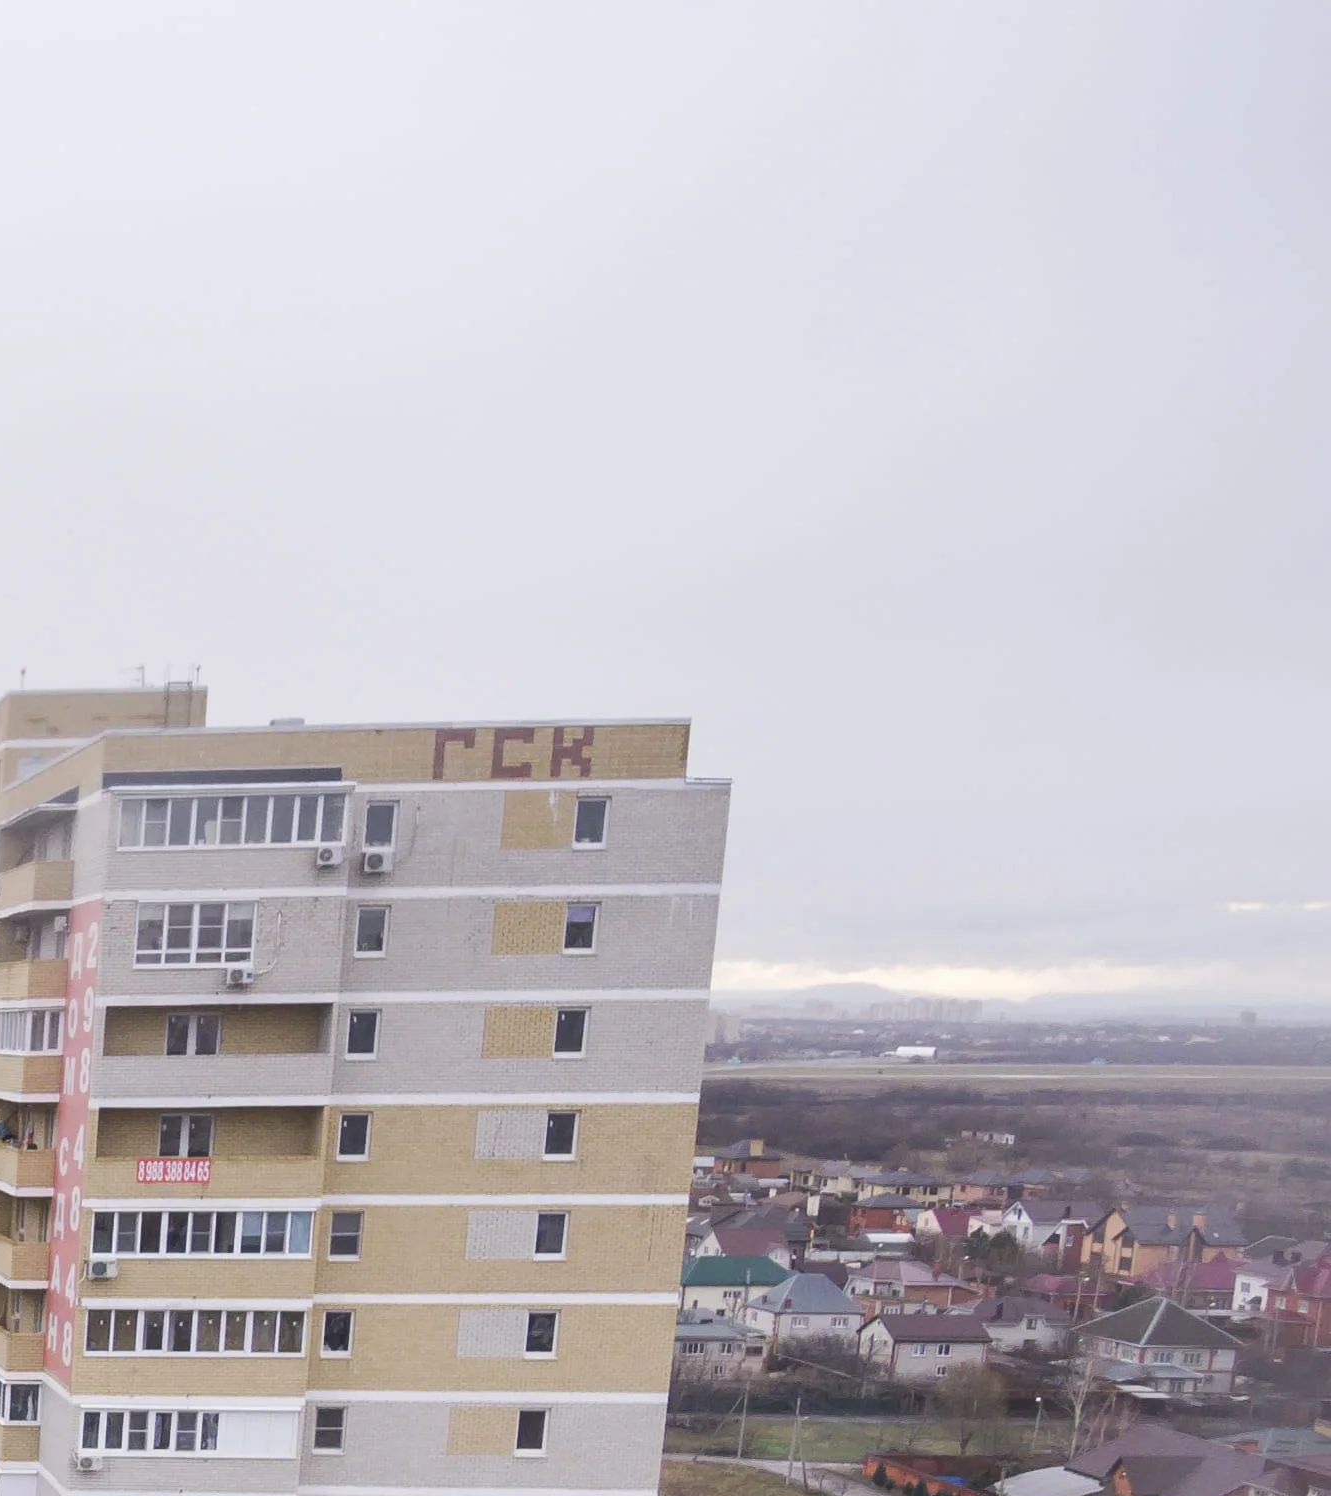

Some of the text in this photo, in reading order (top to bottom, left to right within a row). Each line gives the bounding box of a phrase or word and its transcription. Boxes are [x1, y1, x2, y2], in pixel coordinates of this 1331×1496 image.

[432, 727, 595, 780] ГСК
[46, 931, 84, 1353] ДОМ СДАН
